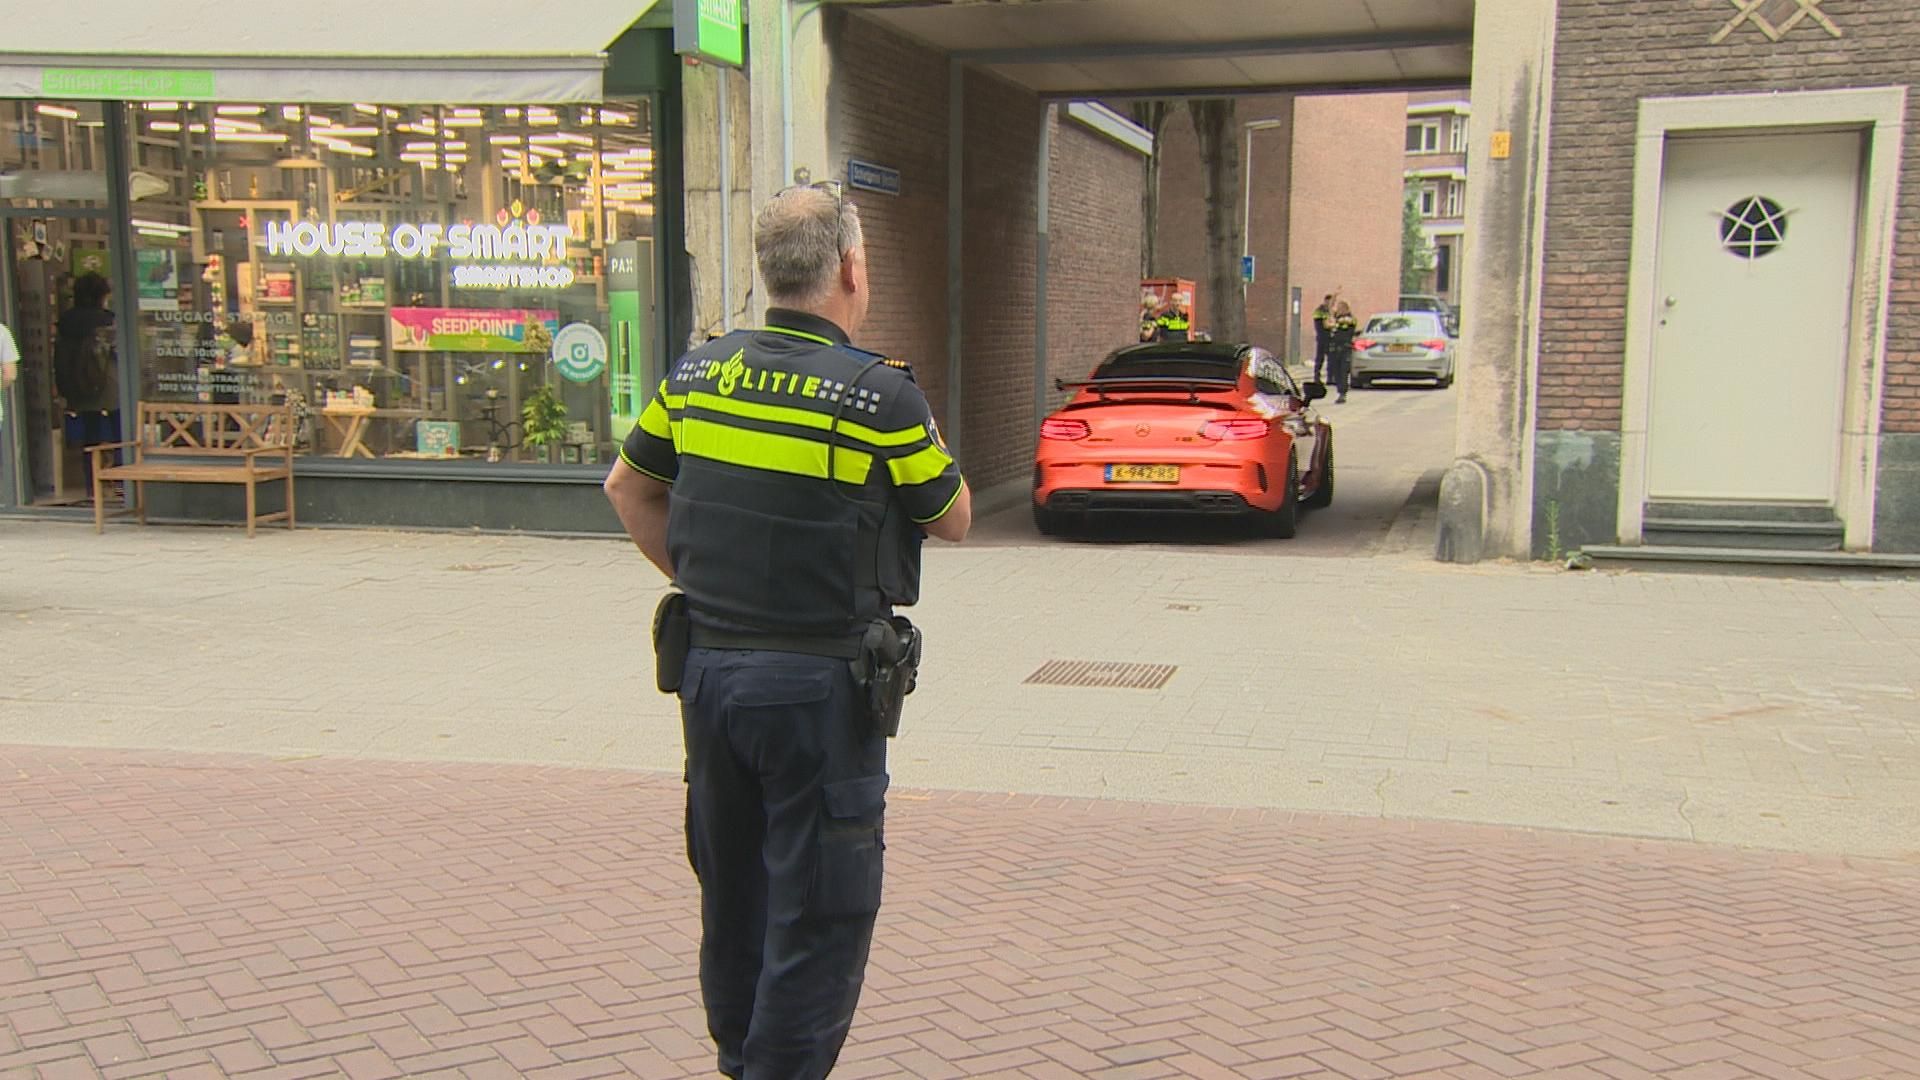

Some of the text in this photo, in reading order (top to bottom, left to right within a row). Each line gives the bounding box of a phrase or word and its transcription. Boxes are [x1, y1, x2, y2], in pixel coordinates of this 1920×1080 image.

[46, 73, 174, 92] SMARTSHOP
[266, 221, 573, 259] HOUSE OF SMART
[611, 257, 632, 273] PAX
[454, 266, 574, 288] SMARTSHOP
[154, 311, 217, 323] LUGGAG
[432, 317, 517, 336] SEEDPOINT
